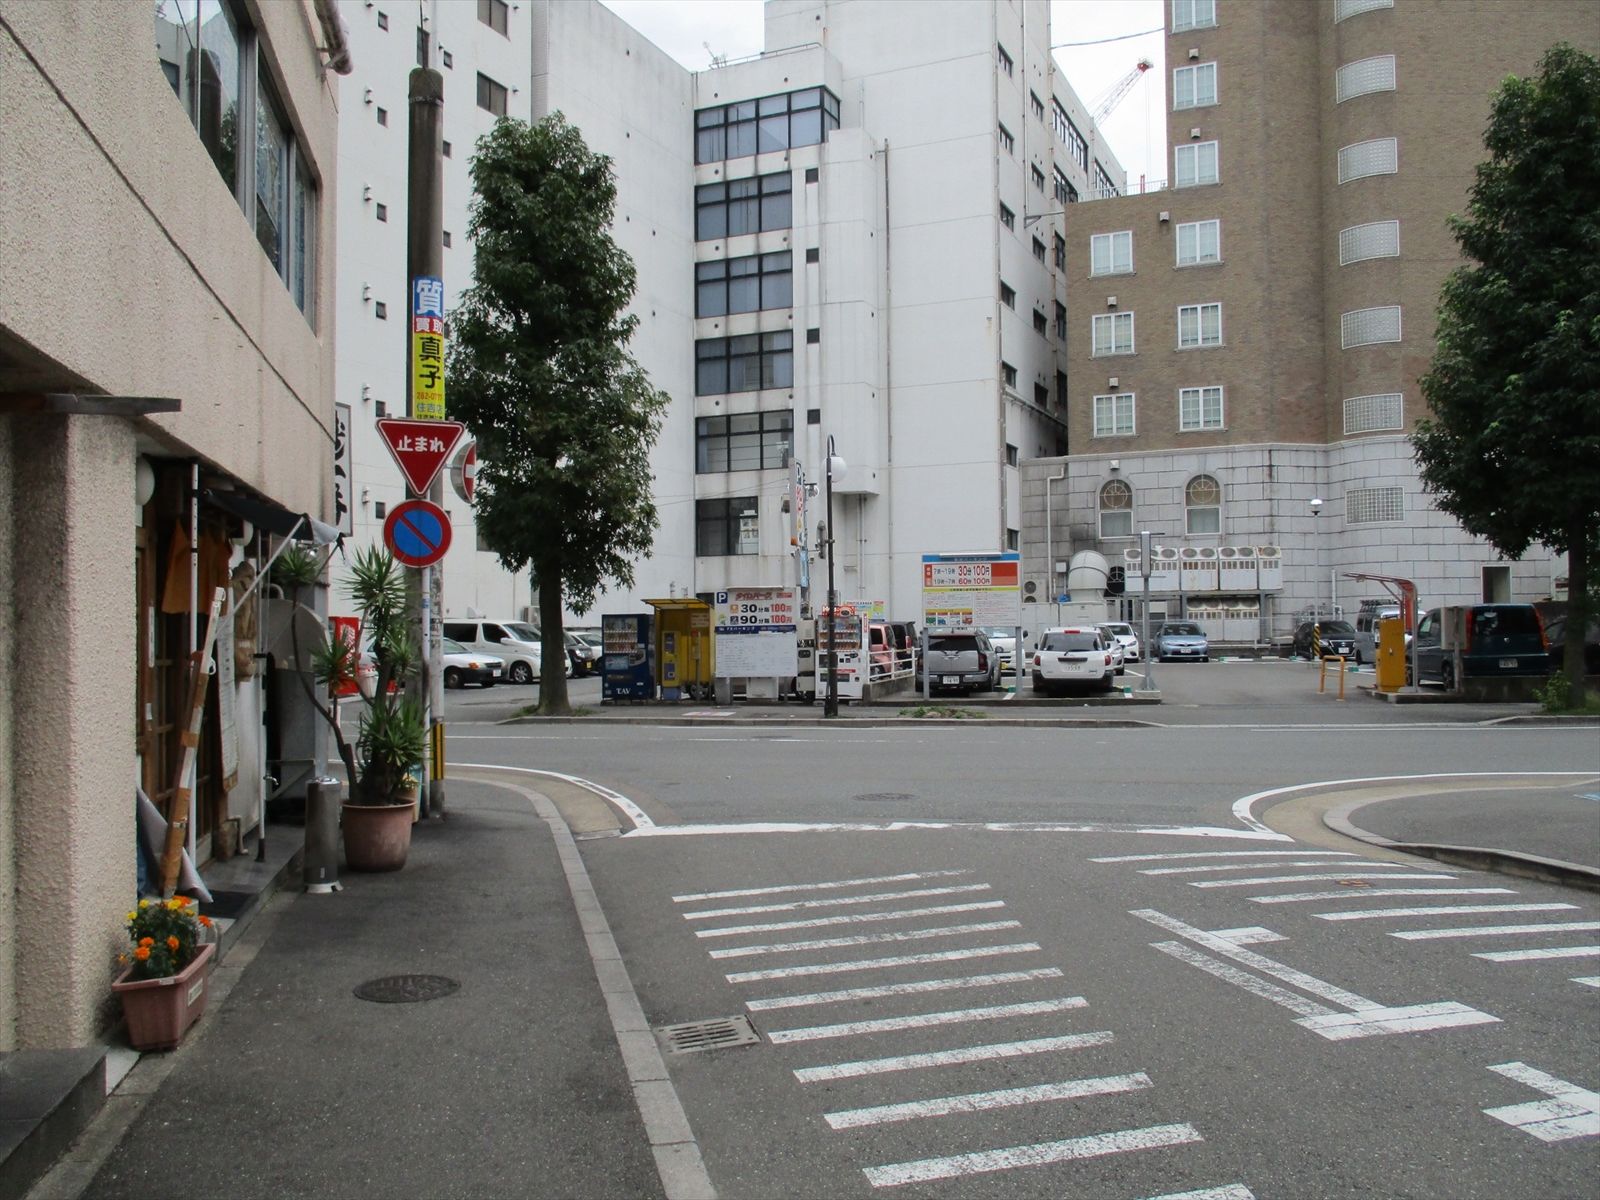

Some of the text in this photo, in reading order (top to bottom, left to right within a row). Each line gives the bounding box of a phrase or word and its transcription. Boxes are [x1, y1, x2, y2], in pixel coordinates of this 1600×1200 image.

[416, 279, 442, 318] 質
[416, 318, 443, 335] 買取
[419, 336, 441, 389] 真子
[396, 435, 446, 453] 止まれ
